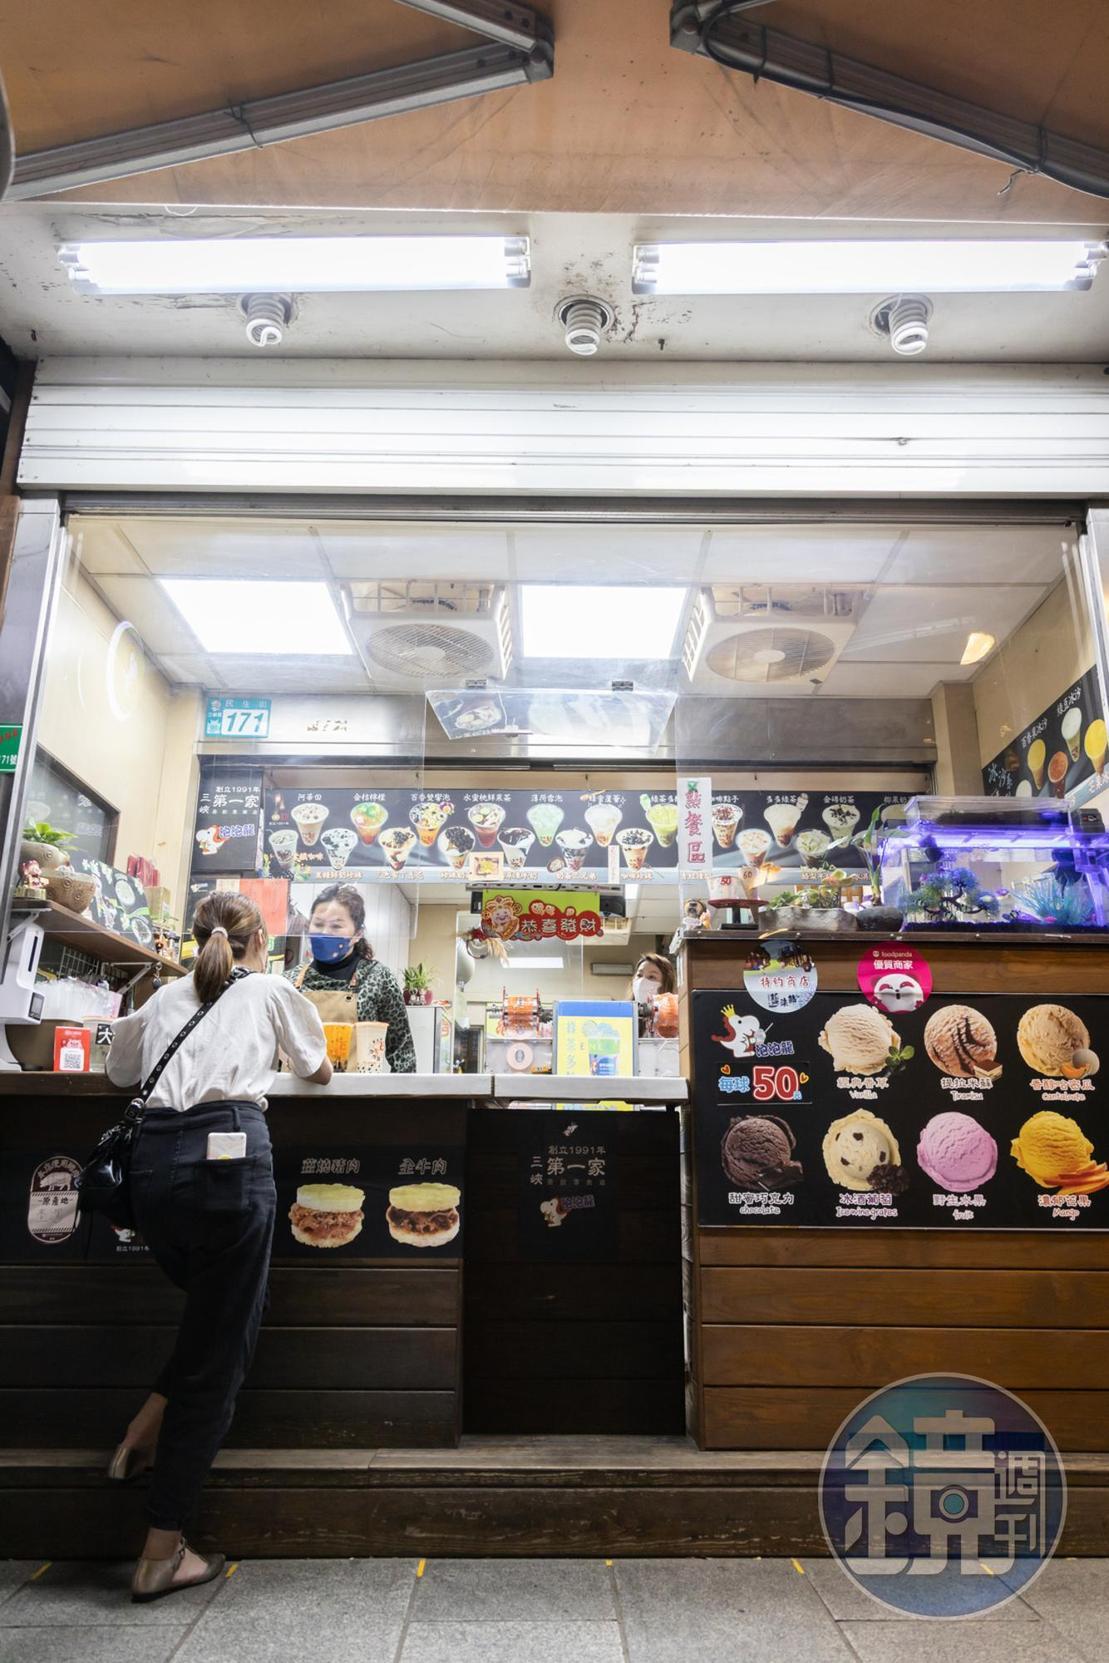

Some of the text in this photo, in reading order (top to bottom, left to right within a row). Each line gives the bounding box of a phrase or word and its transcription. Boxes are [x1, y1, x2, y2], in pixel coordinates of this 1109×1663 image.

[227, 712, 264, 732] 171
[0, 755, 17, 765] 71號
[199, 793, 211, 814] 三峽
[213, 794, 259, 808] 第一家
[521, 918, 596, 933] 恭喜發財
[881, 951, 913, 959] foodpanda
[874, 960, 914, 970] 優質商家
[761, 976, 809, 988] 特約商店
[755, 1041, 795, 1057] 泡泡龍
[718, 1076, 750, 1093] 每球
[753, 1066, 799, 1100] 50
[548, 1146, 606, 1154] 創立1991年
[530, 1156, 543, 1185] 三峽
[547, 1157, 606, 1176] 第一家
[728, 1192, 794, 1204] 甜蜜巧克力
